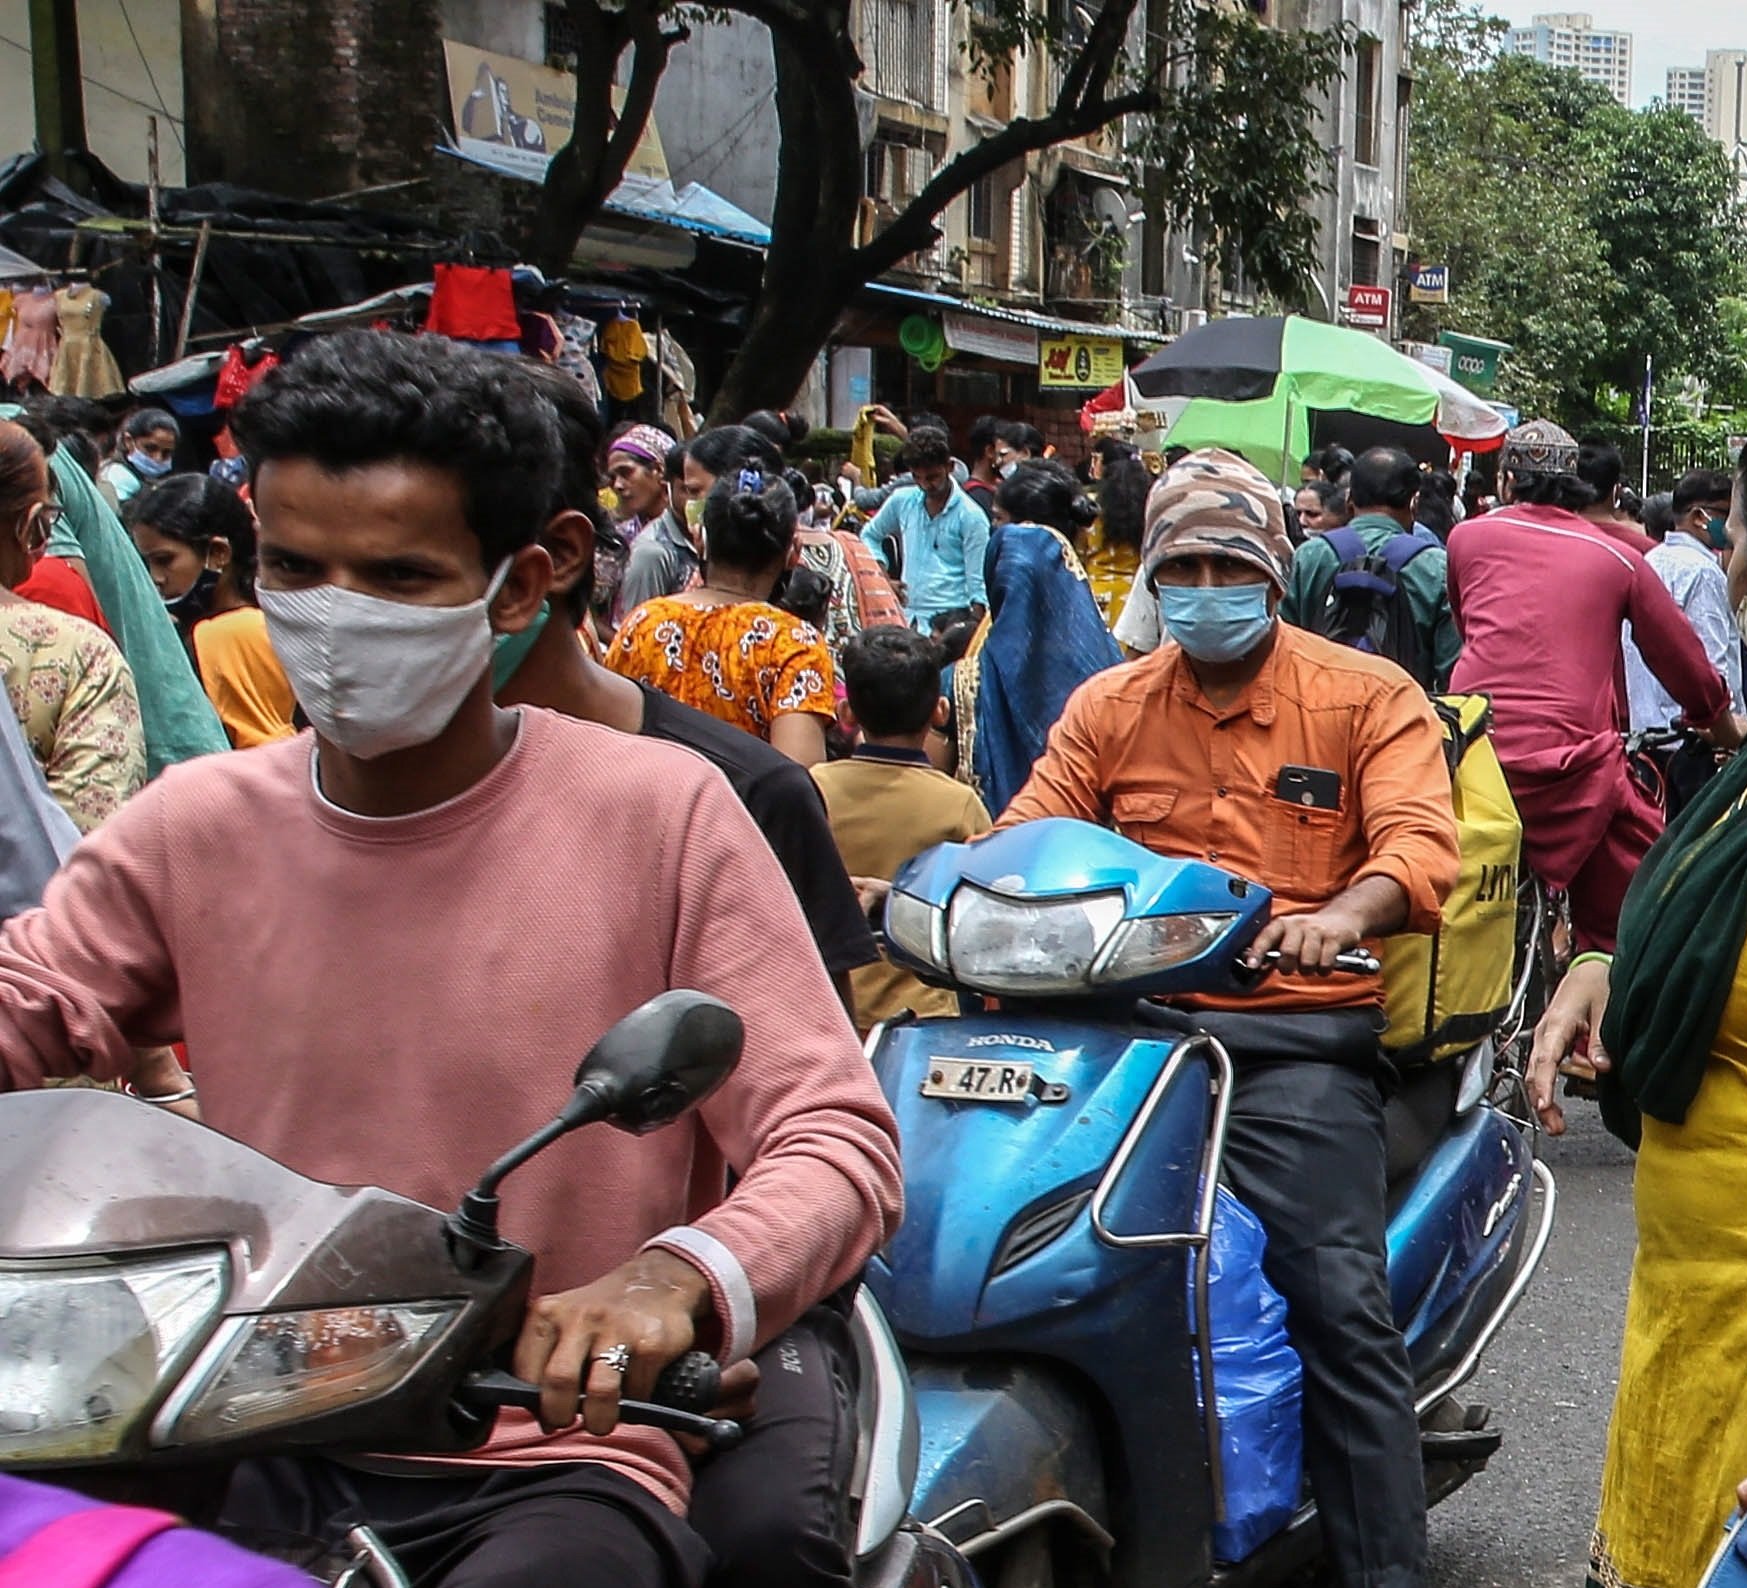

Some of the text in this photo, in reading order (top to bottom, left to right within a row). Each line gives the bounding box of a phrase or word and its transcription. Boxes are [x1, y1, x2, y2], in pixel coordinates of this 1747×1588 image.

[1416, 274, 1443, 287] ATM
[1354, 293, 1382, 305] ATM
[966, 1034, 1056, 1052] HONDA
[959, 1066, 1016, 1094] 47.R
